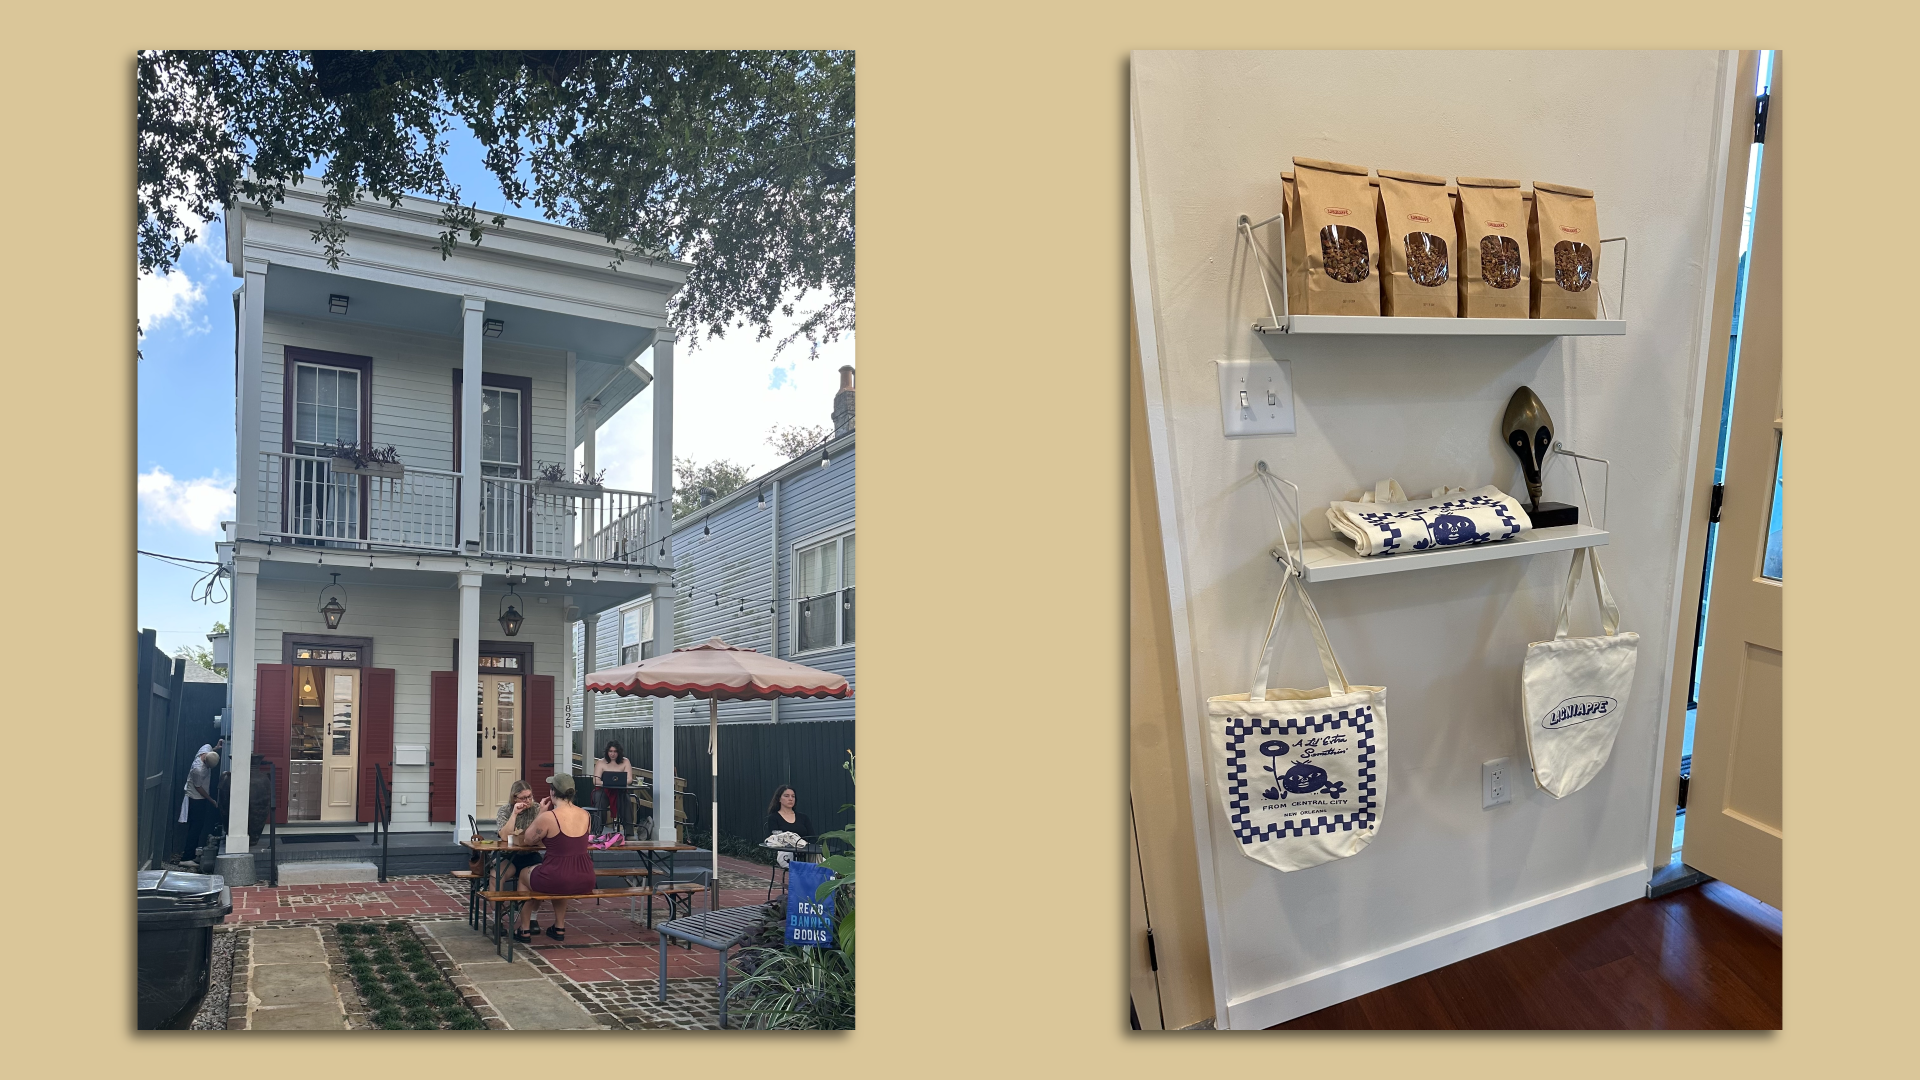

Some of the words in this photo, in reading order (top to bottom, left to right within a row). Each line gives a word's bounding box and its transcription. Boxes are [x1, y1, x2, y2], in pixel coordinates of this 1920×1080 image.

[1550, 700, 1608, 726] LAGNIAPPE
[1292, 739, 1303, 747] A
[1322, 734, 1348, 746] Extra
[1300, 747, 1349, 759] Somethin'
[1262, 803, 1287, 811] FROM
[1291, 799, 1328, 807] CENTRAL
[798, 902, 824, 916] READ
[790, 914, 831, 929] BANNED
[793, 928, 827, 942] BOOKS
